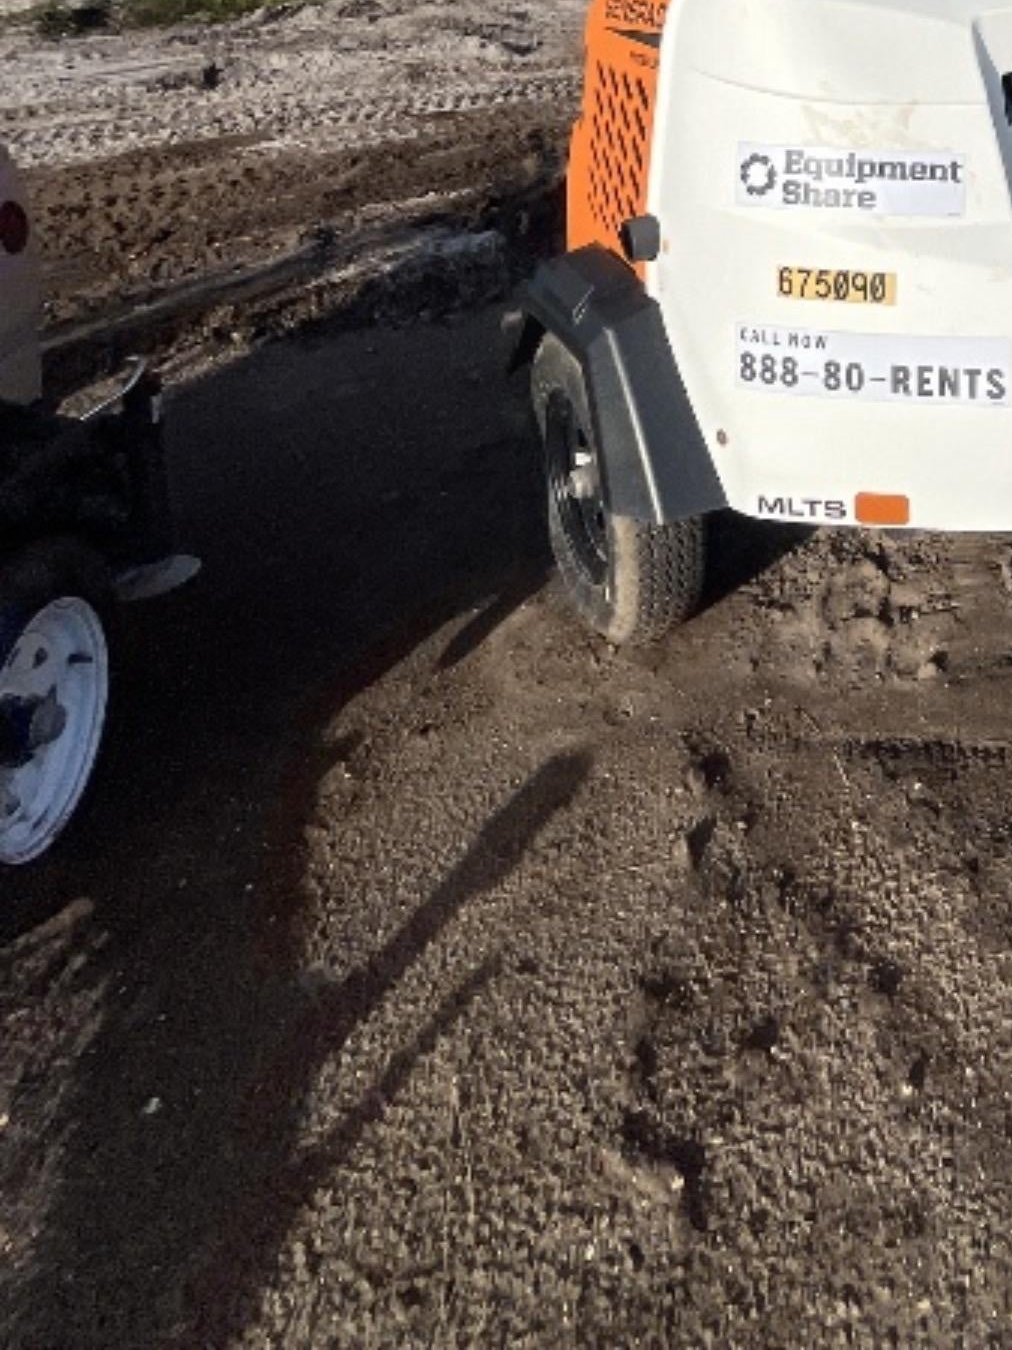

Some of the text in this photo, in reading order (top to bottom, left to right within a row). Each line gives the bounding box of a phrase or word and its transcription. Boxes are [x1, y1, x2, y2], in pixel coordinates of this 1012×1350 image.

[783, 149, 963, 183] Equipment
[782, 180, 877, 209] Share
[778, 266, 887, 301] 675090
[740, 327, 827, 350] CALL NOW
[740, 351, 1006, 400] 888-80-RENTS
[758, 495, 847, 519] MLTS
